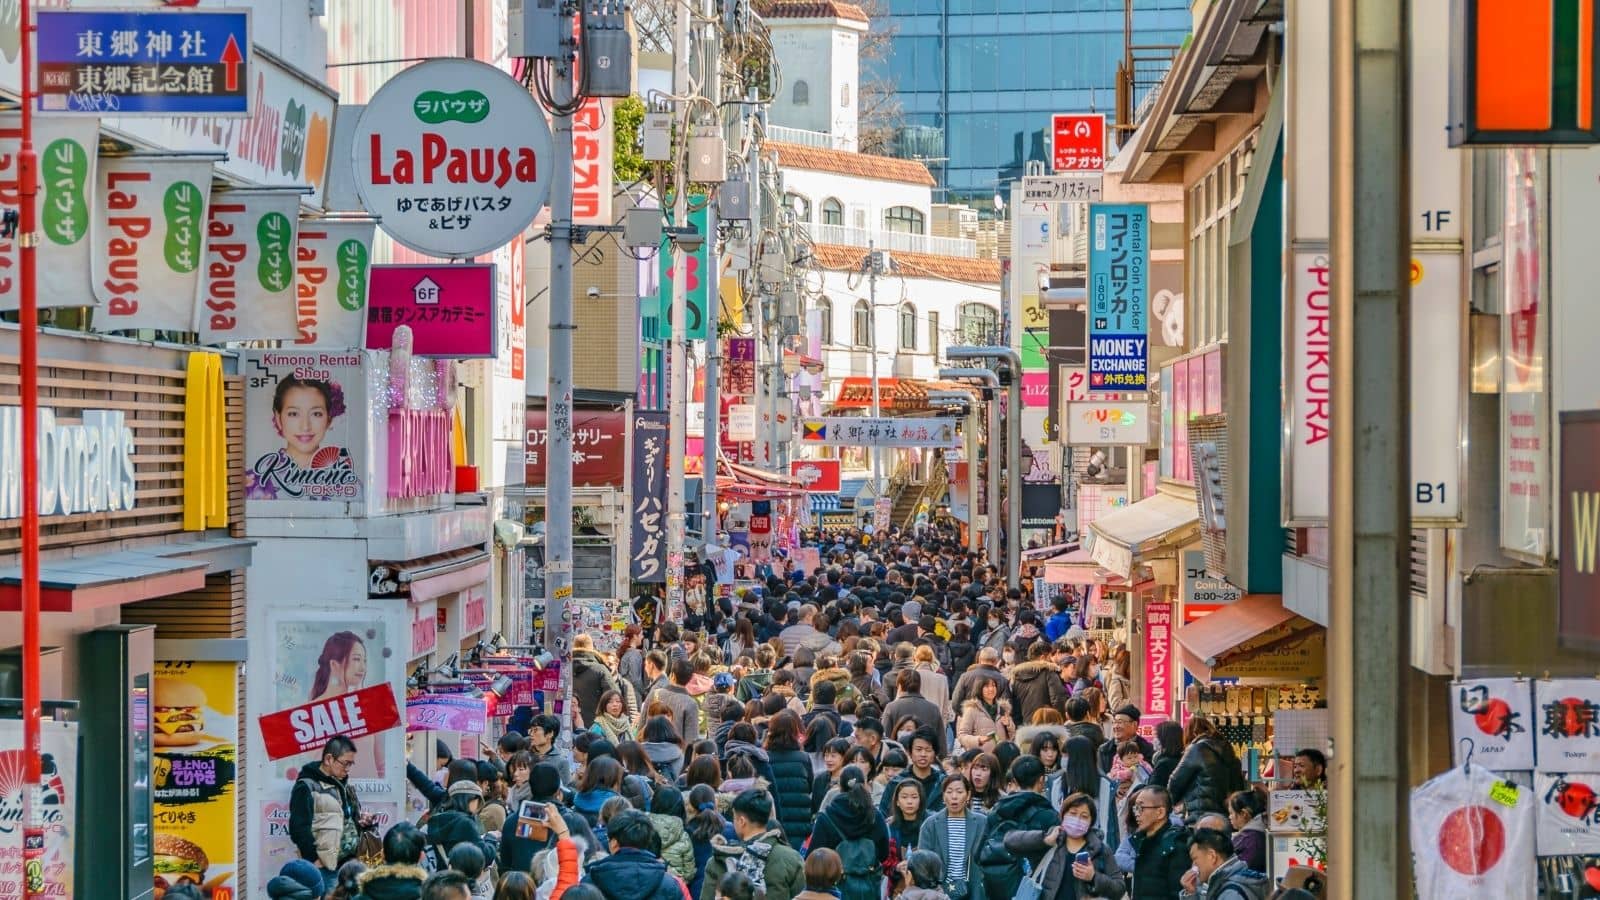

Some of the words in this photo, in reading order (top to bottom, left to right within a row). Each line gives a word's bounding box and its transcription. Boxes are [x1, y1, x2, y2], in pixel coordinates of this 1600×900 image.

[76, 30, 207, 58] 東郷神社
[76, 66, 214, 93] 東郷記念館
[415, 98, 487, 115] ラパウザ
[370, 133, 414, 185] La
[421, 133, 537, 189] Pausa
[1065, 156, 1102, 169] アガサ
[54, 142, 76, 243] ラパウザ
[107, 172, 152, 210] La
[1054, 182, 1100, 199] クリスティー
[175, 185, 194, 271] ラパウザ
[208, 204, 246, 239] La
[1132, 213, 1143, 253] Rental
[1421, 210, 1451, 232] 1F
[266, 216, 284, 290] ラパウザ
[296, 231, 328, 262] La
[103, 217, 152, 316] Pausa
[346, 242, 362, 311] ラパウザ
[1110, 213, 1128, 330] コインロッカー
[1132, 256, 1143, 285] Coin
[205, 245, 247, 331] Pausa
[418, 287, 436, 300] 6F
[294, 267, 329, 345] Pausa
[1131, 288, 1143, 331] Locker
[263, 354, 315, 367] Kimono
[319, 354, 361, 366] Rental
[1091, 339, 1145, 356] MONEY
[293, 367, 330, 381] Shop
[1091, 359, 1146, 371] EXCHANGE
[250, 378, 270, 388] 3F
[832, 423, 897, 442] 東郷神社
[255, 452, 357, 497] Kimono
[302, 485, 358, 497] TOKYO
[1416, 483, 1447, 504] B1
[1195, 580, 1217, 590] Coin
[1148, 612, 1171, 624] 都内
[1150, 625, 1169, 713] 最大プリクラ店
[289, 694, 367, 744] SALE
[1460, 684, 1526, 742] 日本
[1542, 699, 1600, 739] 東京
[172, 759, 216, 770] 売上No.1
[172, 769, 216, 786] てりやき
[365, 782, 393, 793] KIDS
